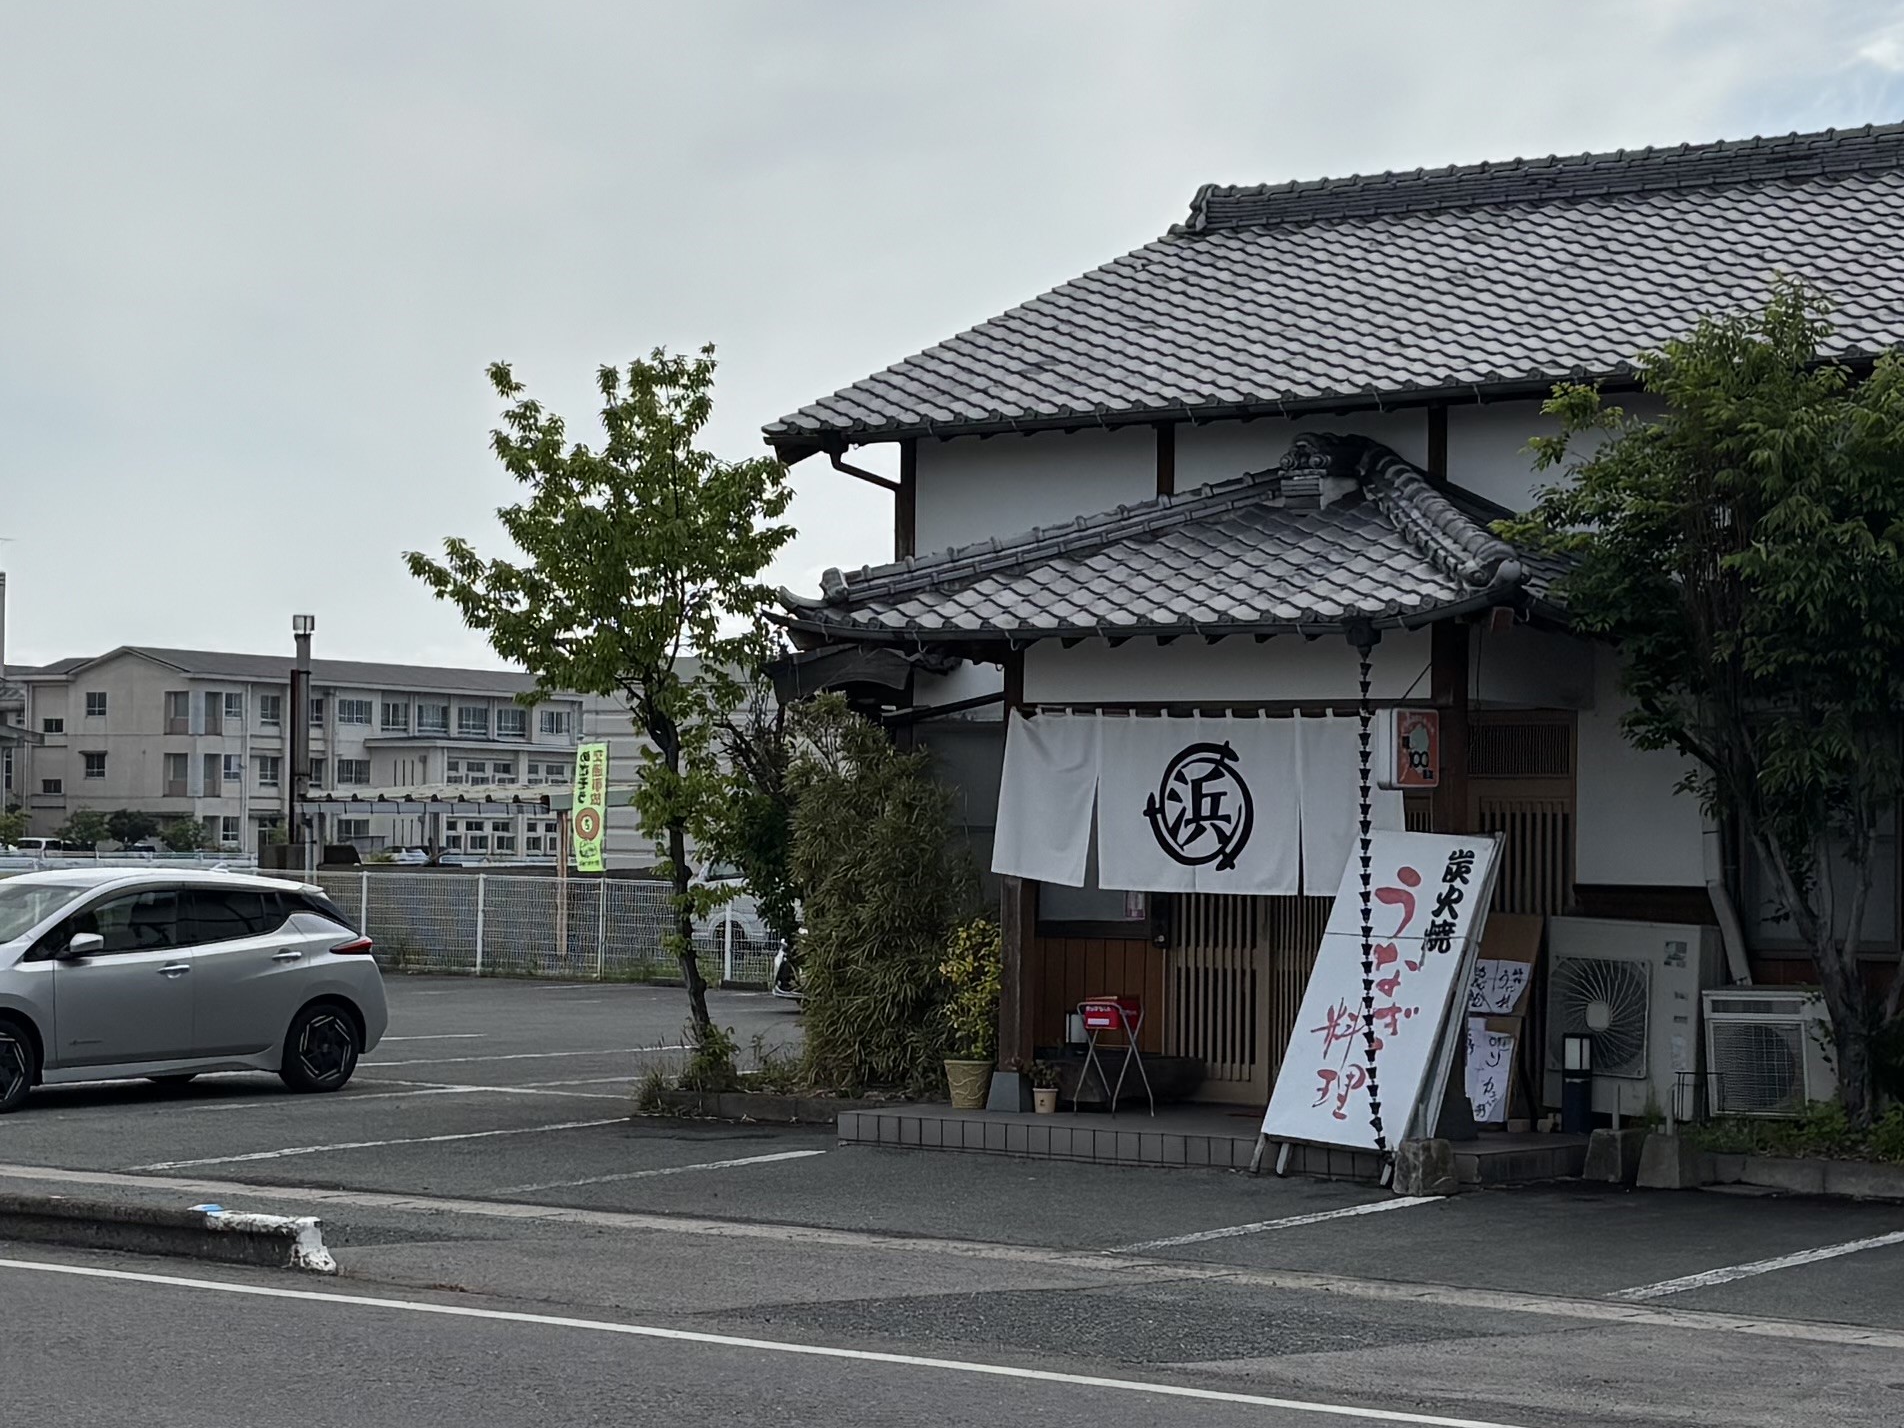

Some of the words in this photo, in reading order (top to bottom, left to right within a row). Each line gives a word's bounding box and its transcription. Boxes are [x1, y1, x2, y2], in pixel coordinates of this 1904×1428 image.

[1166, 764, 1232, 848] 浜
[1368, 865, 1422, 1052] うなぎ
[1421, 848, 1476, 954] 炭火焼
[1310, 996, 1368, 1120] 料理
